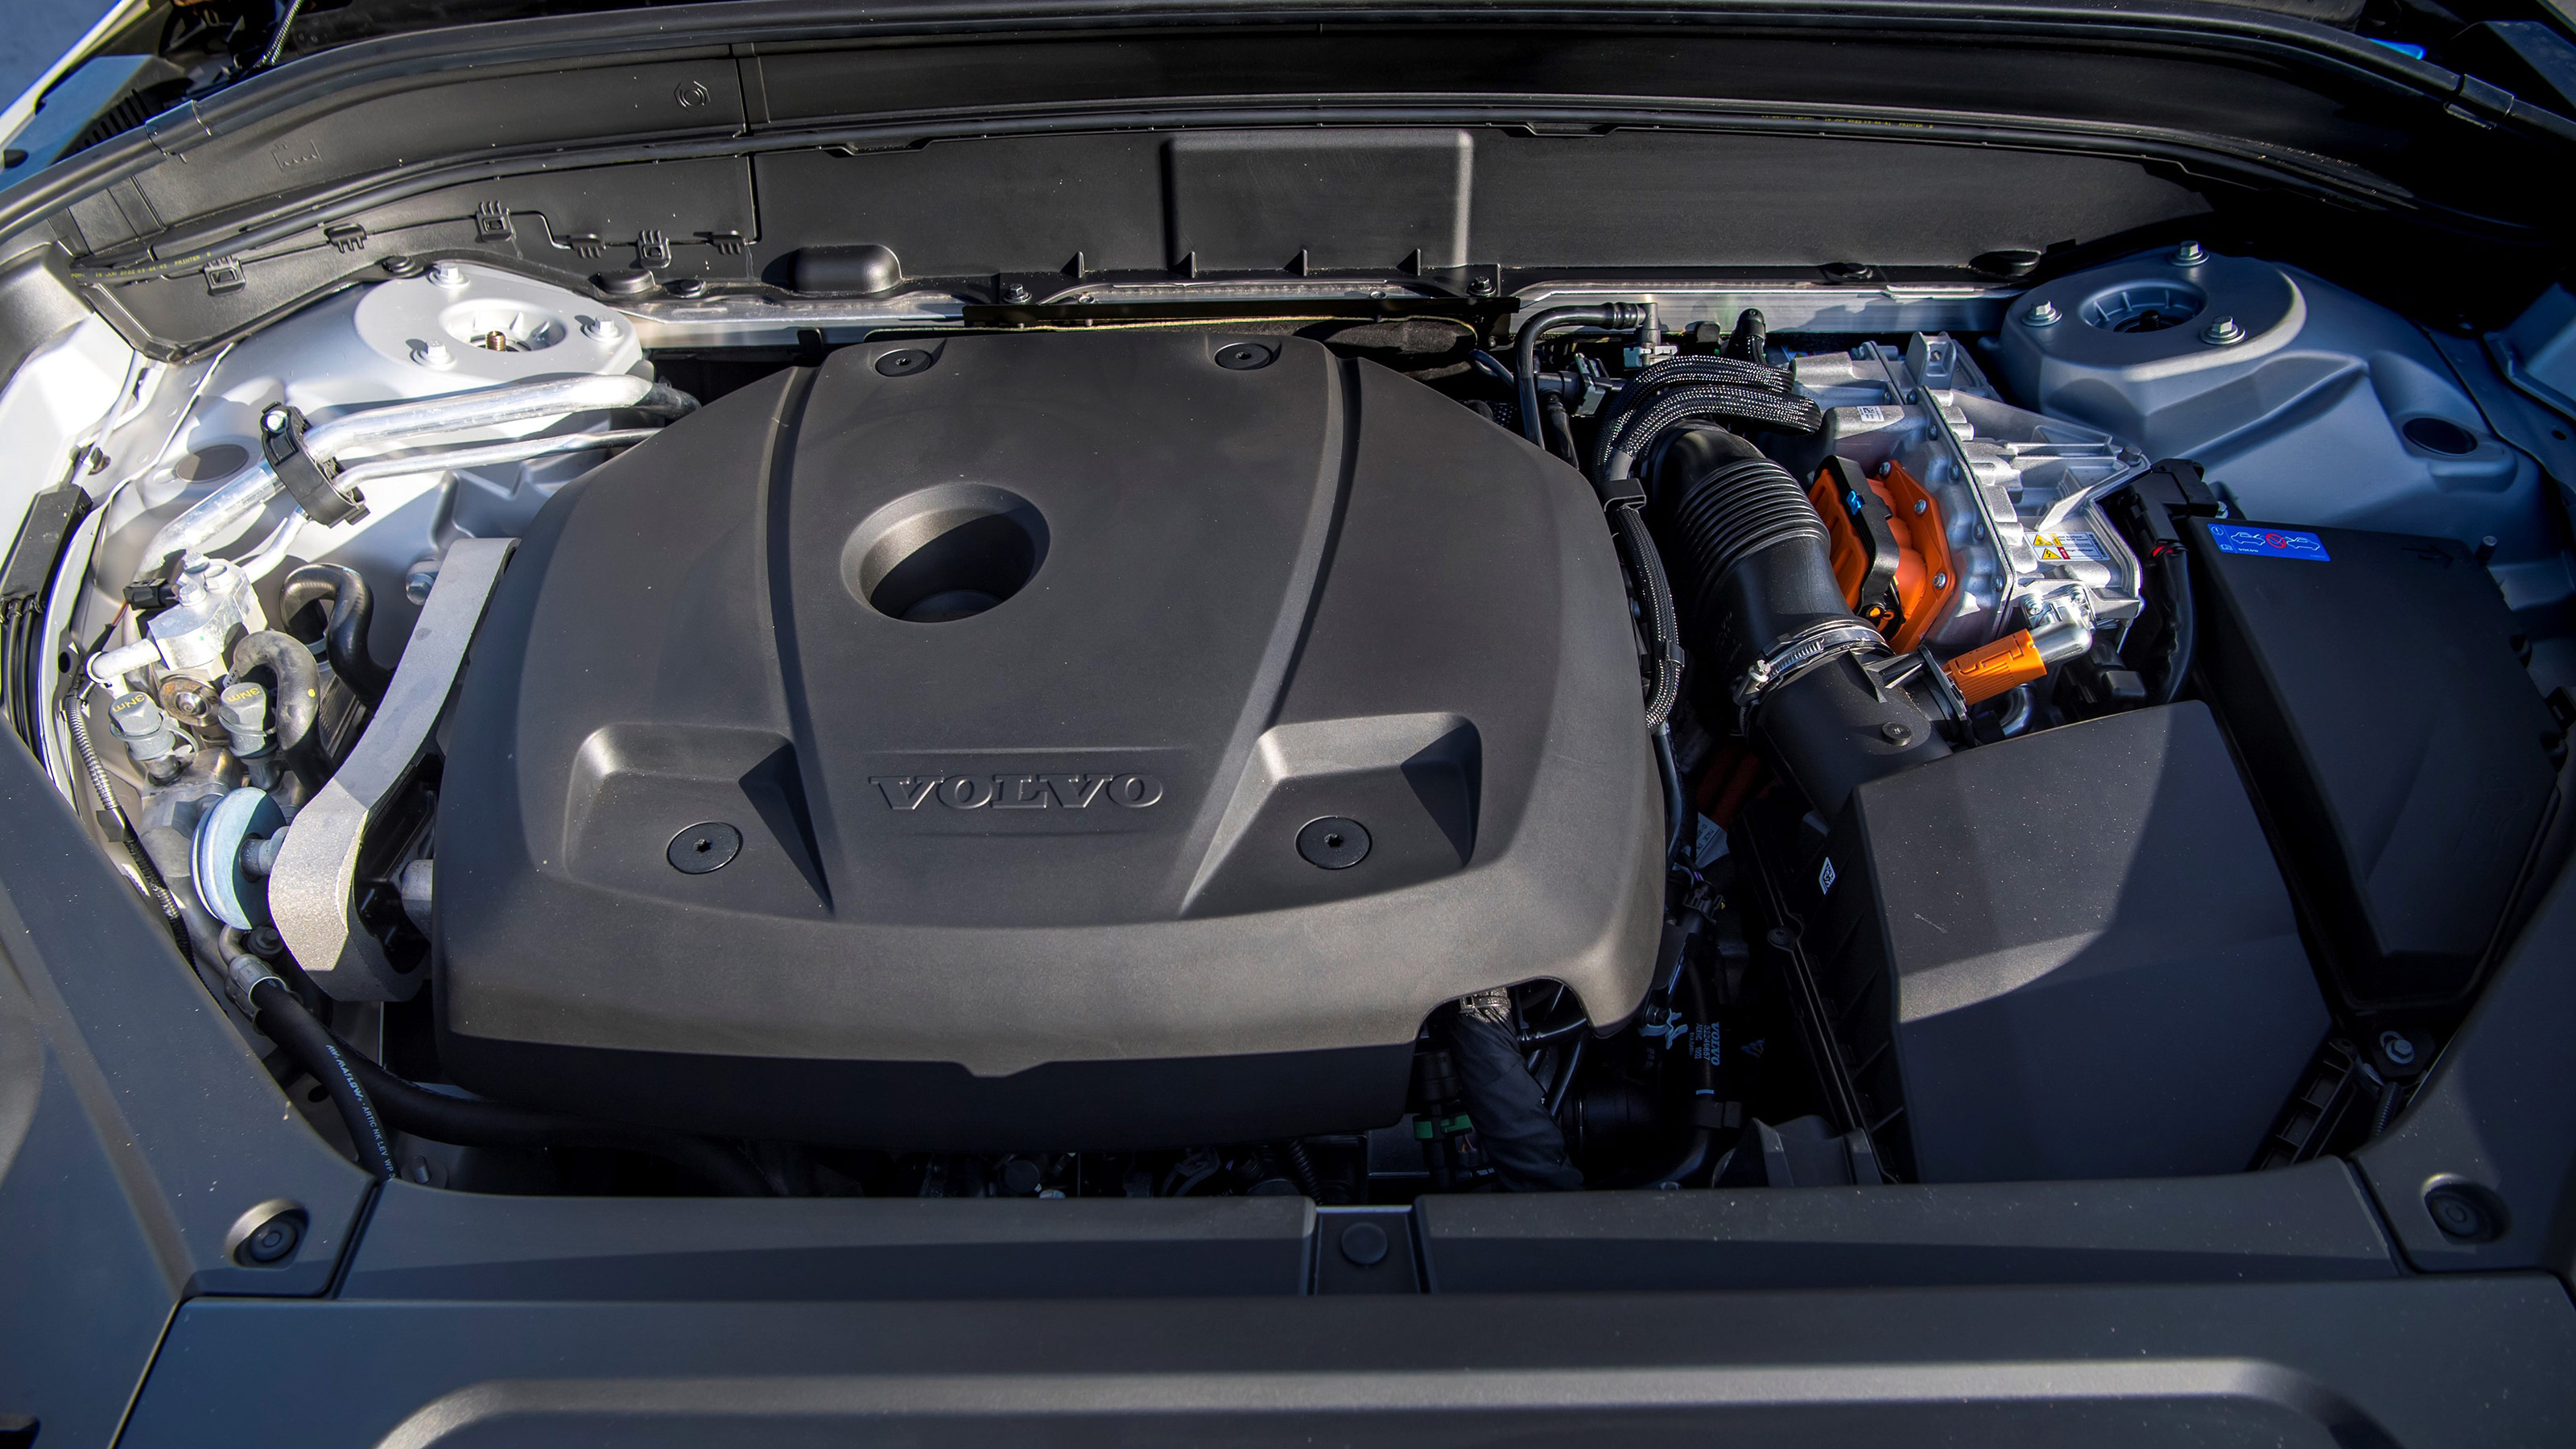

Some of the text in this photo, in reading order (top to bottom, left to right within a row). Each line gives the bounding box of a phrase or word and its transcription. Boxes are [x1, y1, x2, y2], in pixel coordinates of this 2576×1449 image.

[174, 254, 201, 266] PRINTER
[868, 772, 1164, 811] VOLVO
[1711, 1022, 1720, 1067] VOLVO
[372, 1129, 383, 1140] NK
[376, 1141, 389, 1157] LEV
